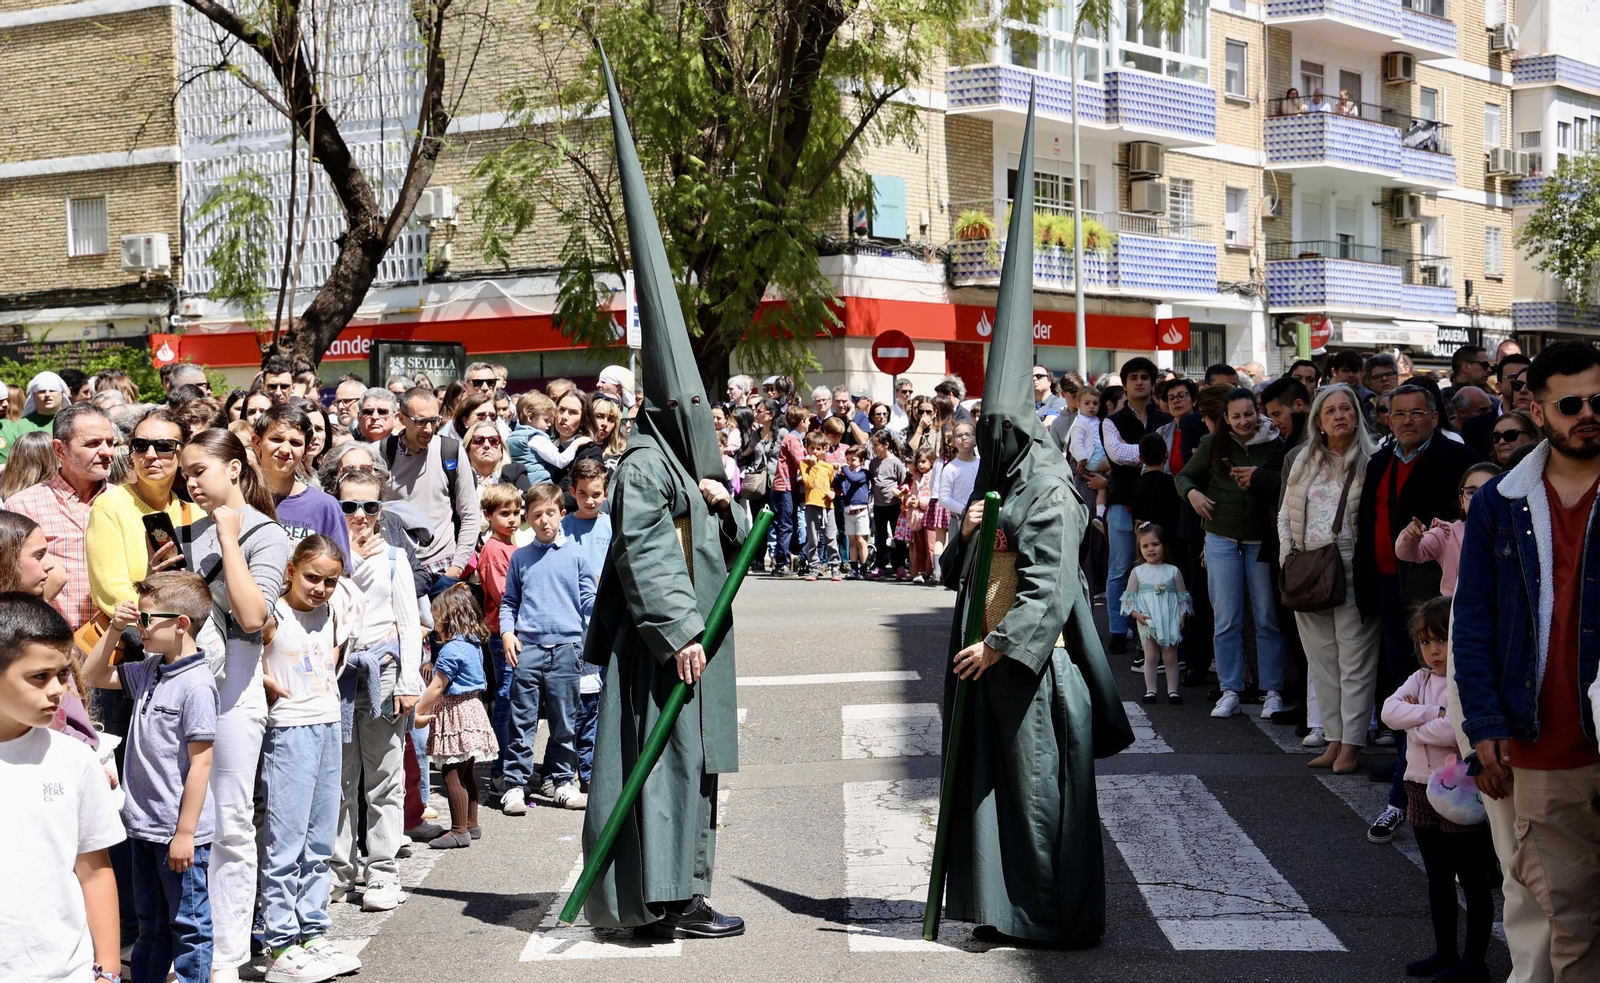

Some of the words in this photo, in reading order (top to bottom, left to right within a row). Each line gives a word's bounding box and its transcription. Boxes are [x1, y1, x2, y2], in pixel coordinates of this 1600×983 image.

[1437, 327, 1470, 343] UQUERÍA
[18, 345, 51, 354] PANARIA
[325, 334, 375, 355] ande
[407, 357, 456, 370] SEVILLA
[435, 369, 456, 378] OUTLET
[283, 525, 309, 539] SEA
